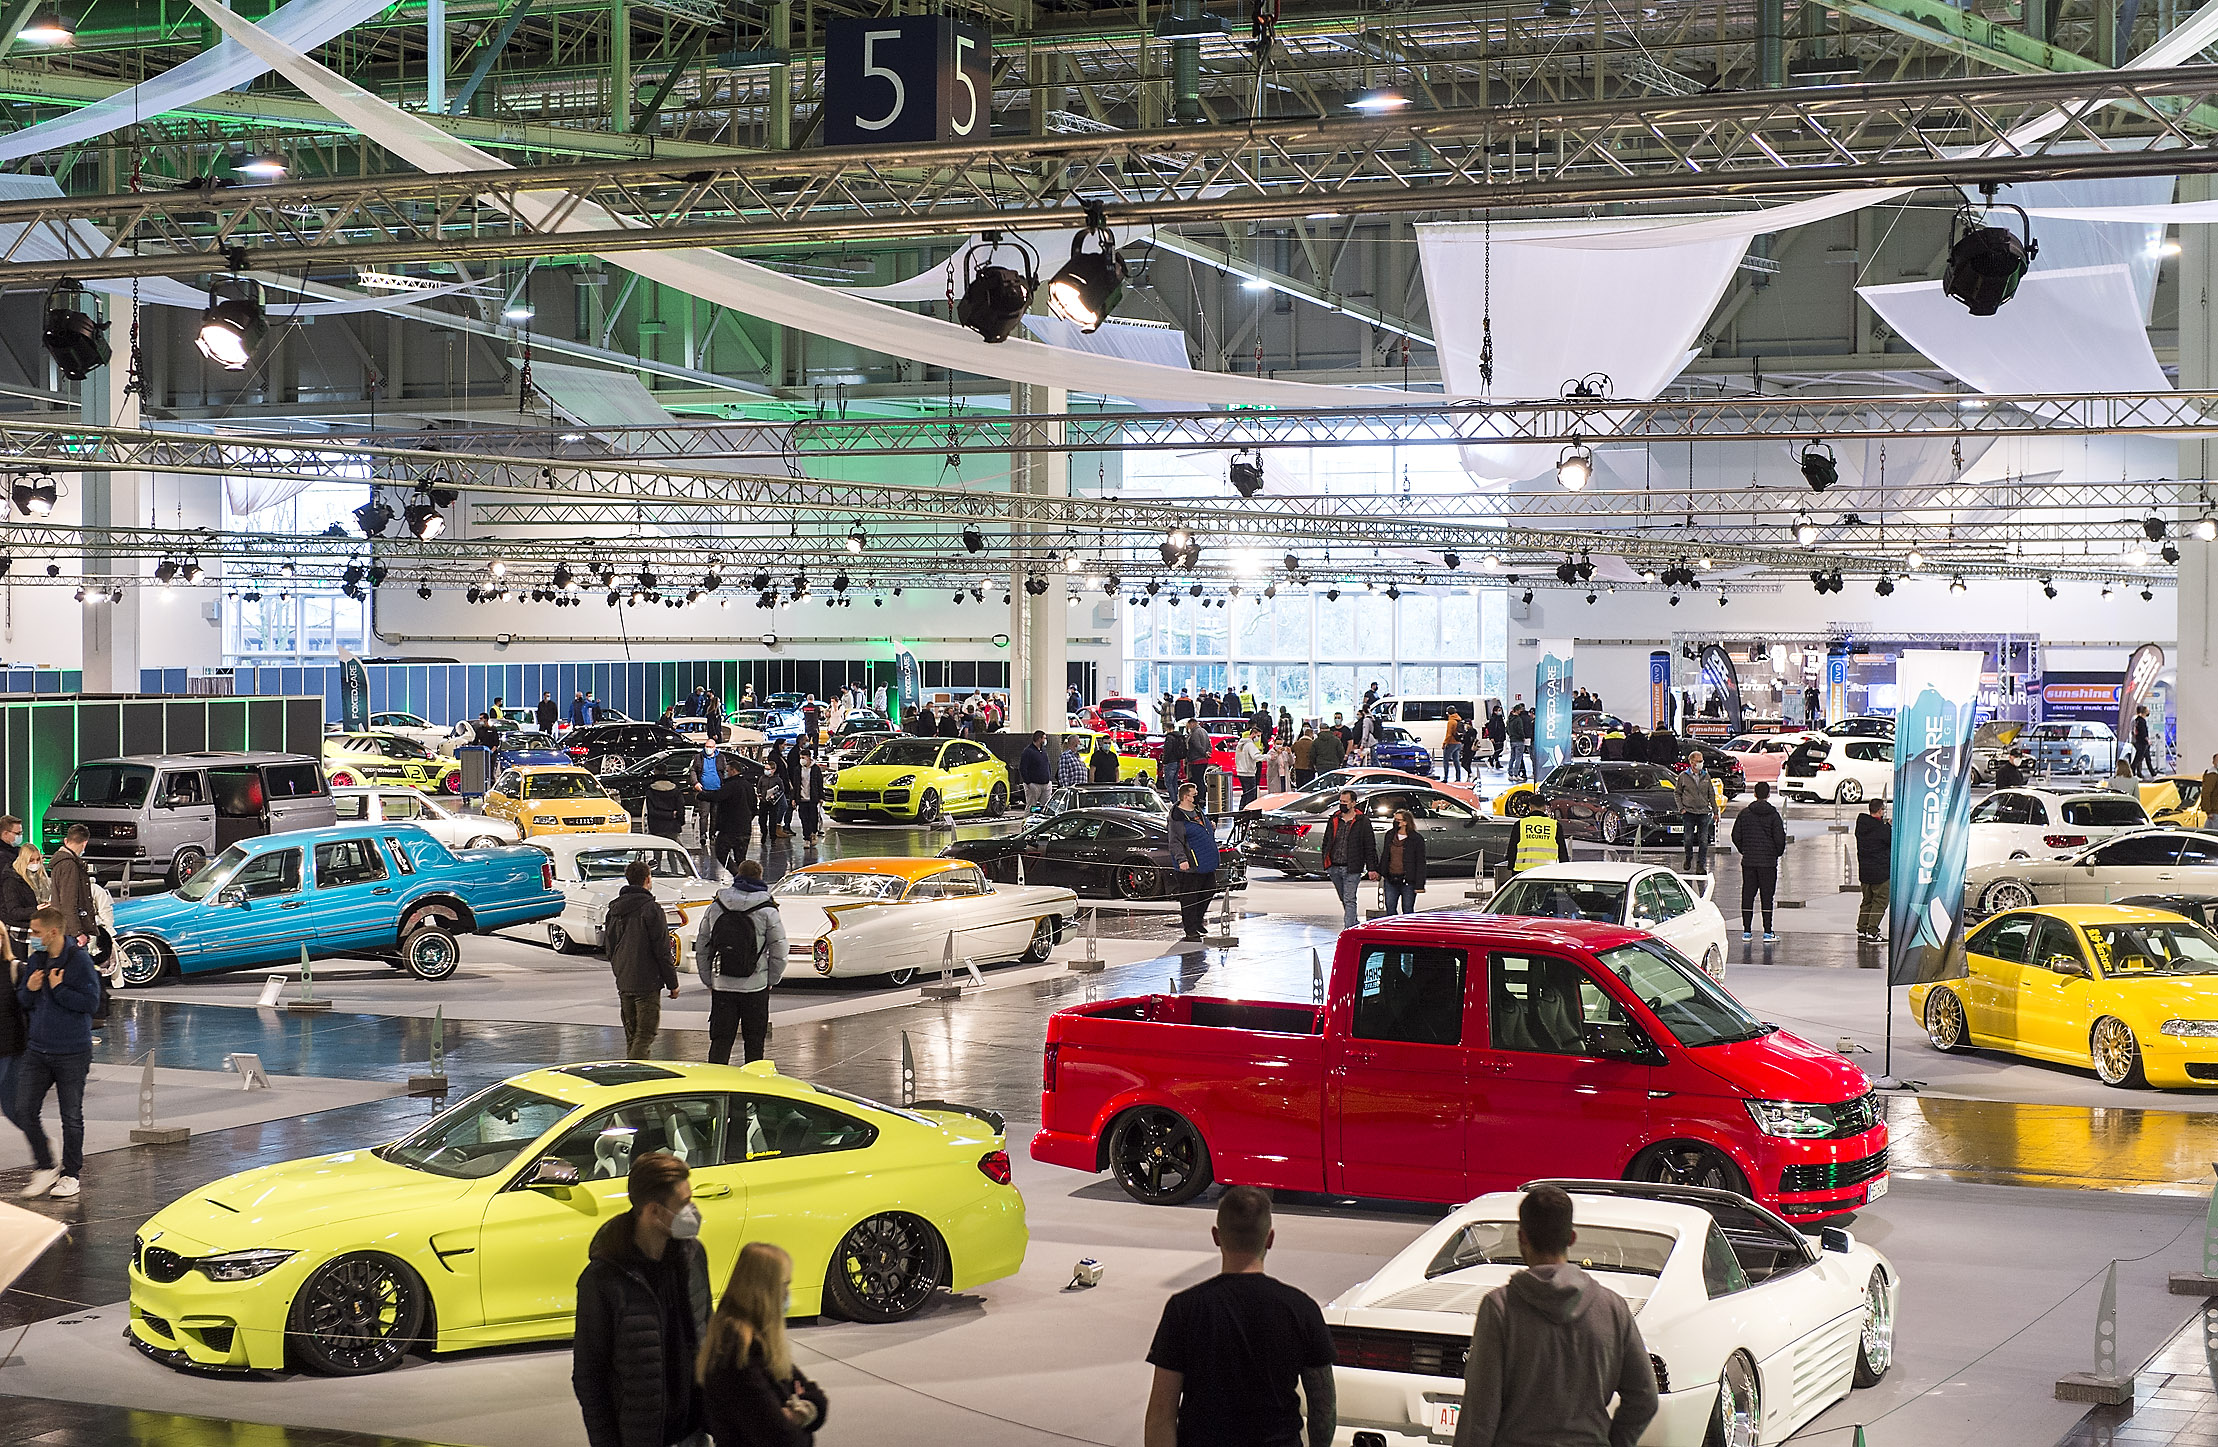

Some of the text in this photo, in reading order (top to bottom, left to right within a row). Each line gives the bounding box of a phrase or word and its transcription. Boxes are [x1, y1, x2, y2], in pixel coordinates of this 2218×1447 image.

[855, 29, 905, 131] 5
[951, 34, 977, 136] 5
[349, 664, 359, 719] FOXED.CARE
[1834, 664, 1842, 682] live
[2046, 688, 2111, 699] sunshine
[1546, 665, 1557, 740] FOXED.CARE
[411, 769, 421, 779] 2
[1918, 715, 1944, 885] FOXED.CARE
[1525, 824, 1551, 835] RGE
